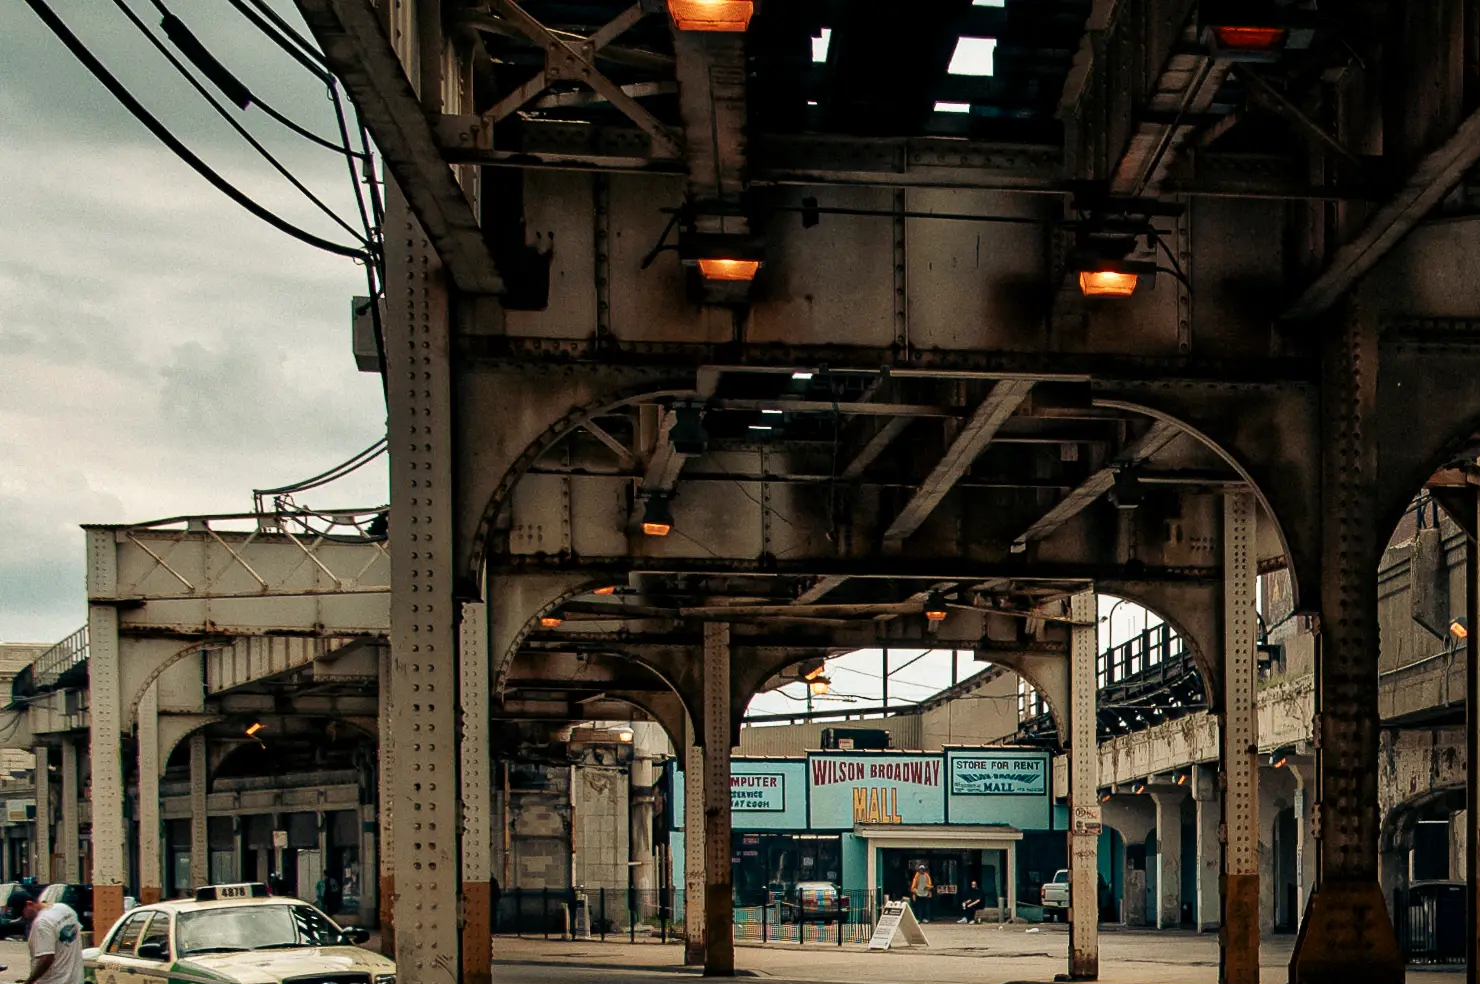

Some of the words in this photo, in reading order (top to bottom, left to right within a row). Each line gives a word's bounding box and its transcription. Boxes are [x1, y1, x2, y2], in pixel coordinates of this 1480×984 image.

[956, 760, 987, 769] STORE
[991, 761, 1008, 770] FOR
[1013, 761, 1040, 770] RENT
[811, 759, 866, 786] WILSON
[869, 759, 941, 787] BROADWAY
[730, 777, 777, 787] MPUTER
[983, 782, 1014, 792] MALL
[852, 787, 902, 824] MALL
